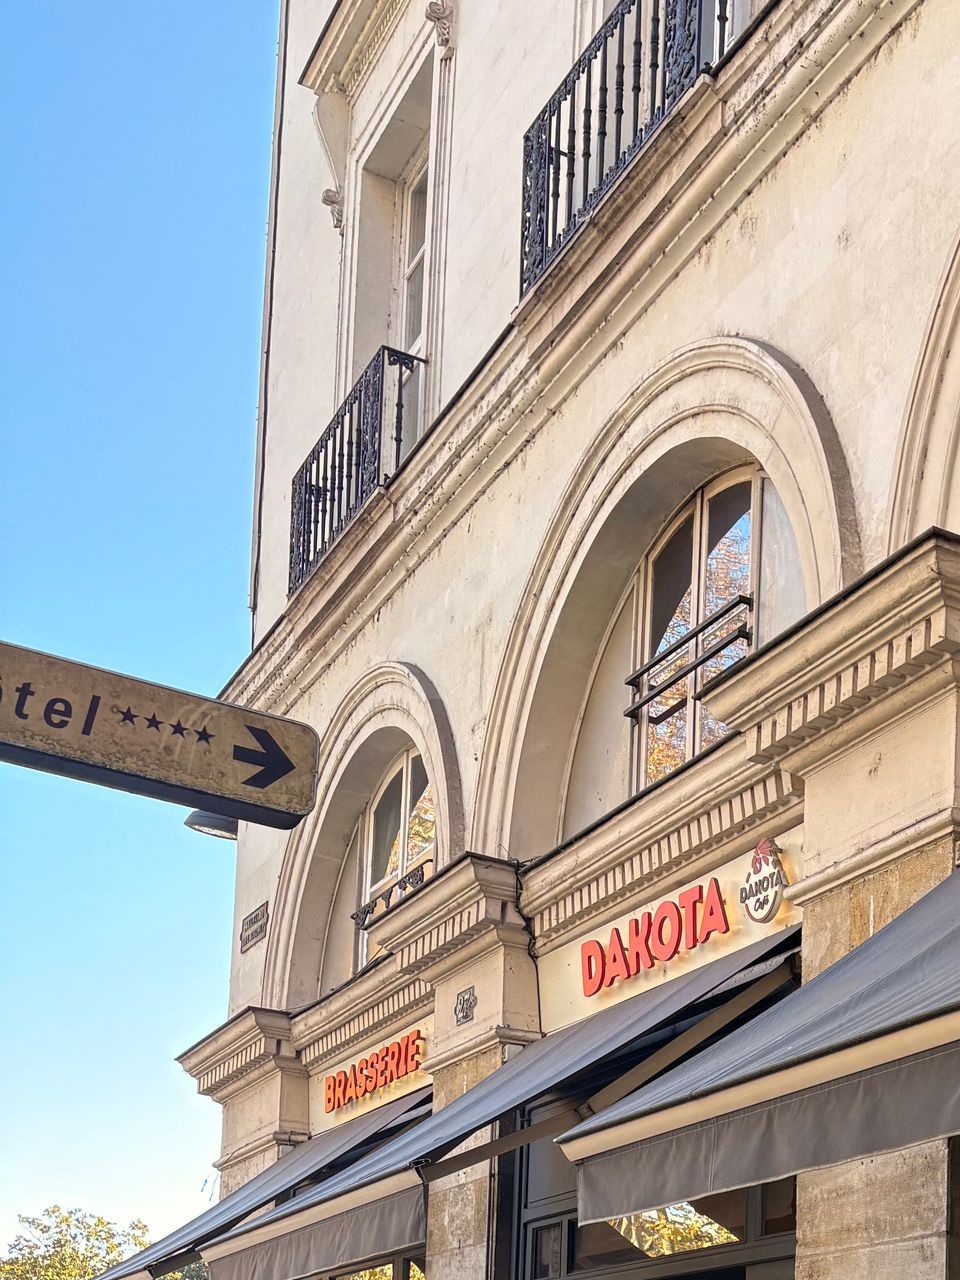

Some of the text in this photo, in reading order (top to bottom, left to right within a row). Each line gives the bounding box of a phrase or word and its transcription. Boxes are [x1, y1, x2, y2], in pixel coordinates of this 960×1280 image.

[0, 676, 101, 736] tel
[740, 870, 783, 904] DAKOTA
[581, 877, 730, 997] DAKOTA
[325, 1029, 421, 1113] BRASSERIE
